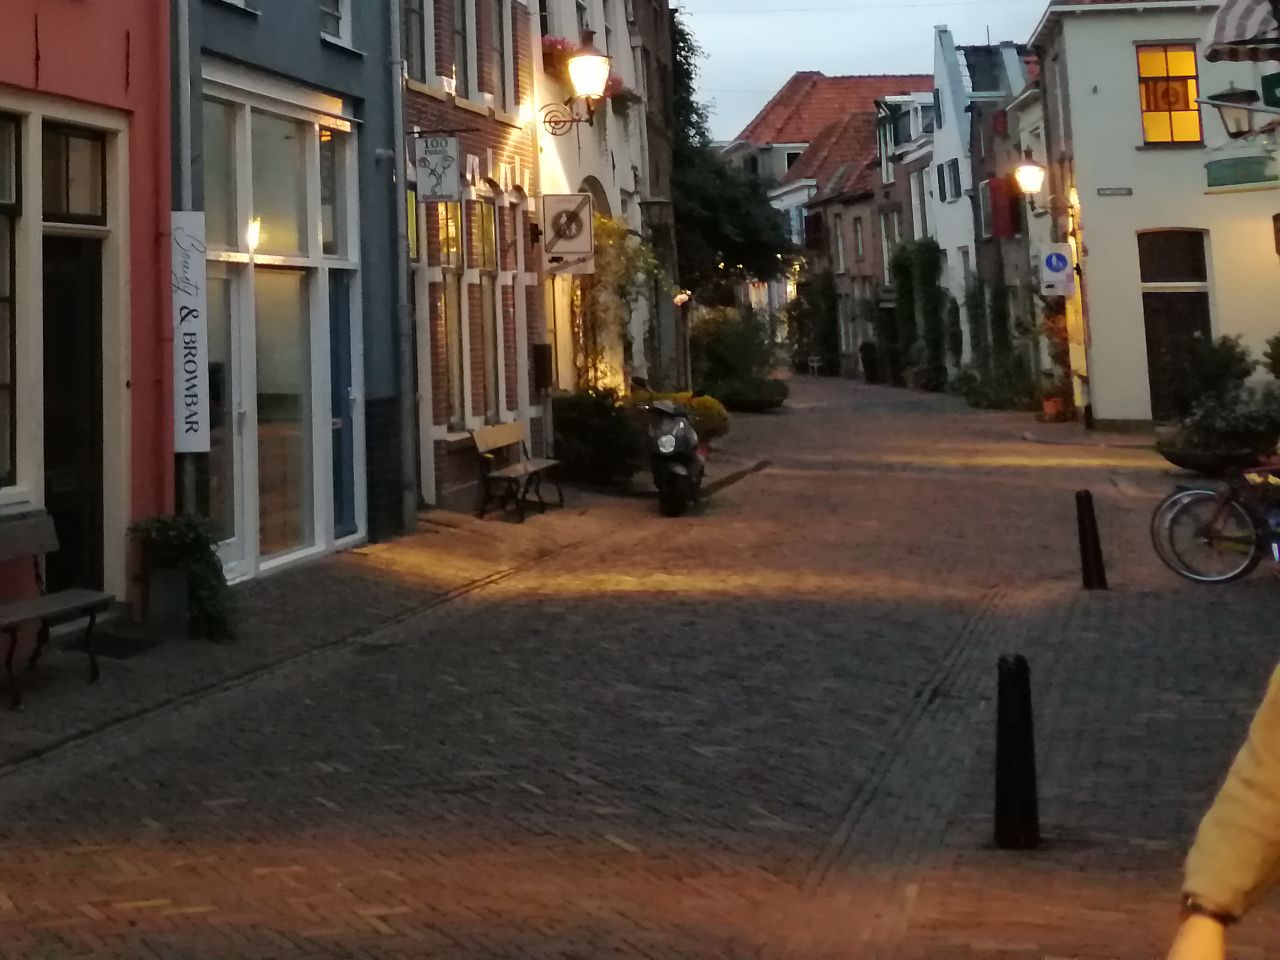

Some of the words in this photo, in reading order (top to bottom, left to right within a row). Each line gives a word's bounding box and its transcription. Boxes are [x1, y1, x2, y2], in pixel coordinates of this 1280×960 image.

[424, 138, 448, 149] 100
[179, 305, 200, 326] &
[183, 332, 199, 434] BROWBAR
